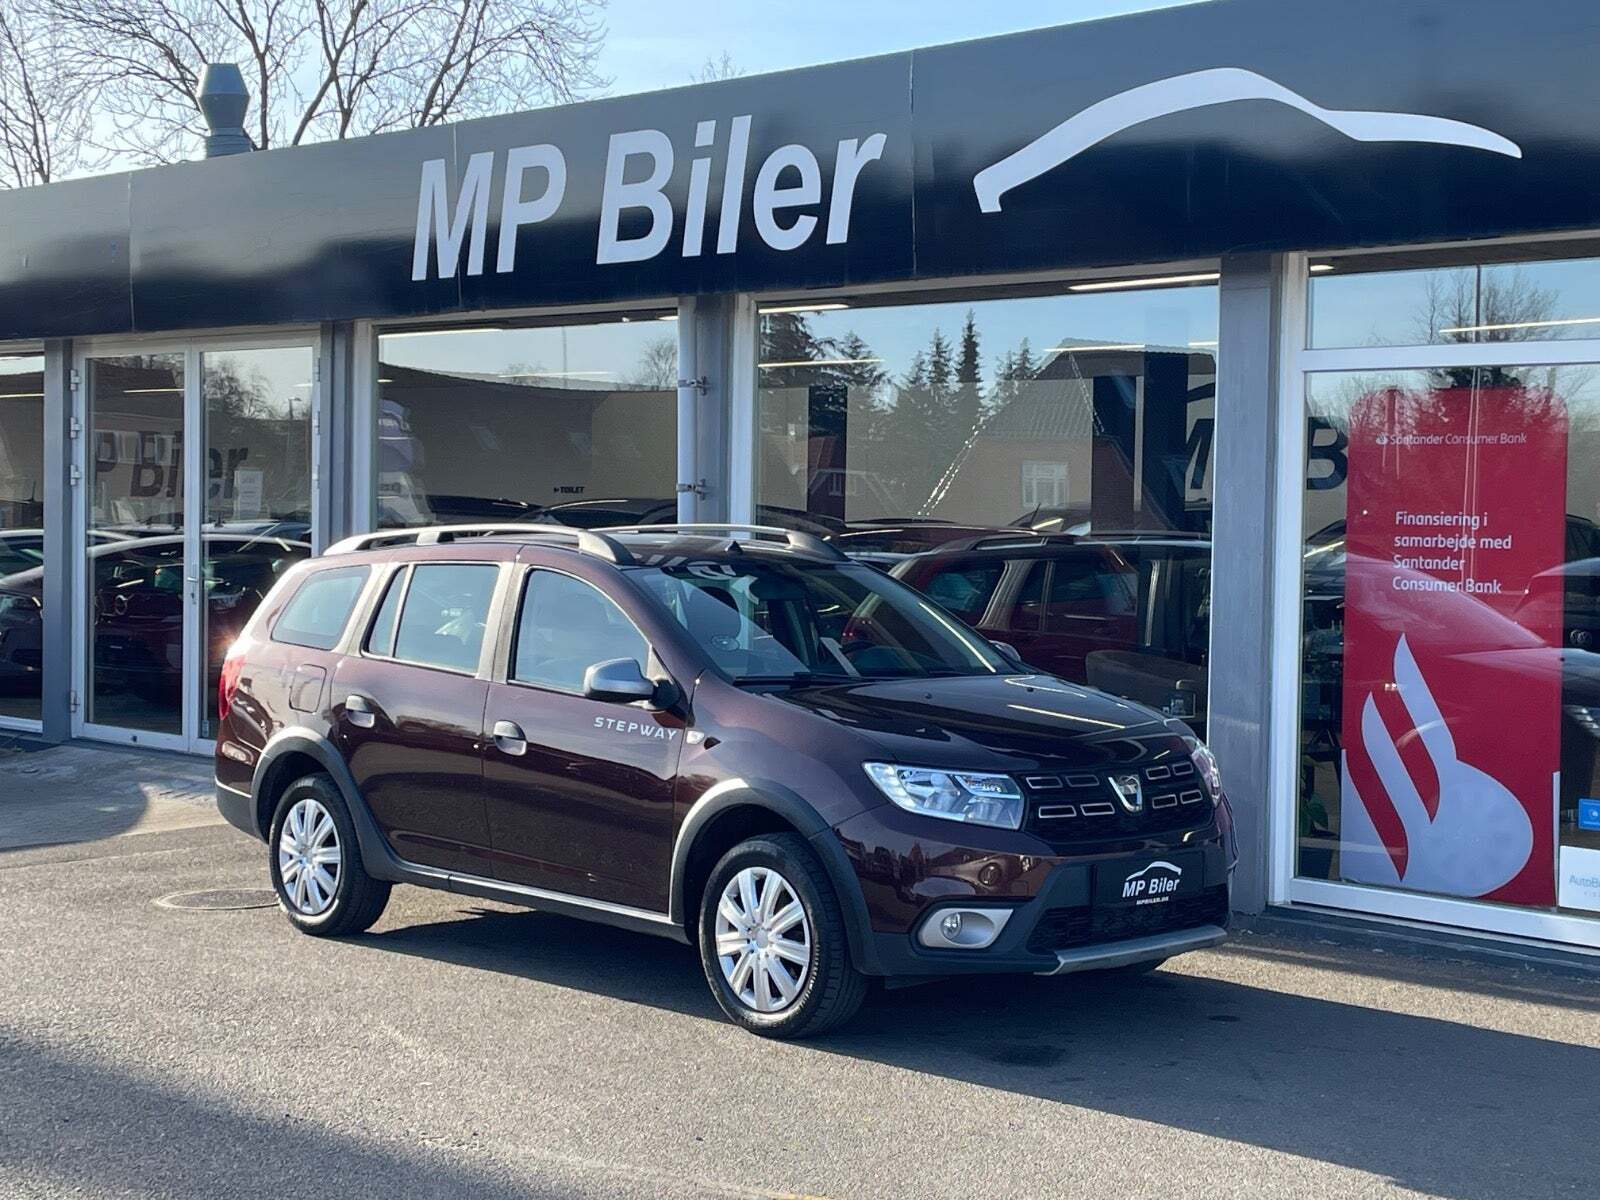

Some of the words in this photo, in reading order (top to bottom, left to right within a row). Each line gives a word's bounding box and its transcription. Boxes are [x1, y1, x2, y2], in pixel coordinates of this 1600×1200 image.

[411, 143, 567, 281] MP
[596, 114, 887, 265] Biler
[1390, 434, 1444, 445] Santander
[1445, 433, 1498, 445] Consumer
[1500, 432, 1527, 444] Bank
[1395, 511, 1480, 530] Finansiering
[1483, 511, 1488, 527] i
[1394, 533, 1476, 552] samarbejde
[1479, 534, 1512, 549] med
[1393, 554, 1465, 570] Santander
[1392, 576, 1464, 592] Consumer
[1465, 577, 1502, 593] Bank
[594, 716, 677, 740] STEPWAY
[1122, 879, 1146, 898] MP
[1148, 876, 1180, 894] Biler
[1569, 874, 1600, 889] AutoB
